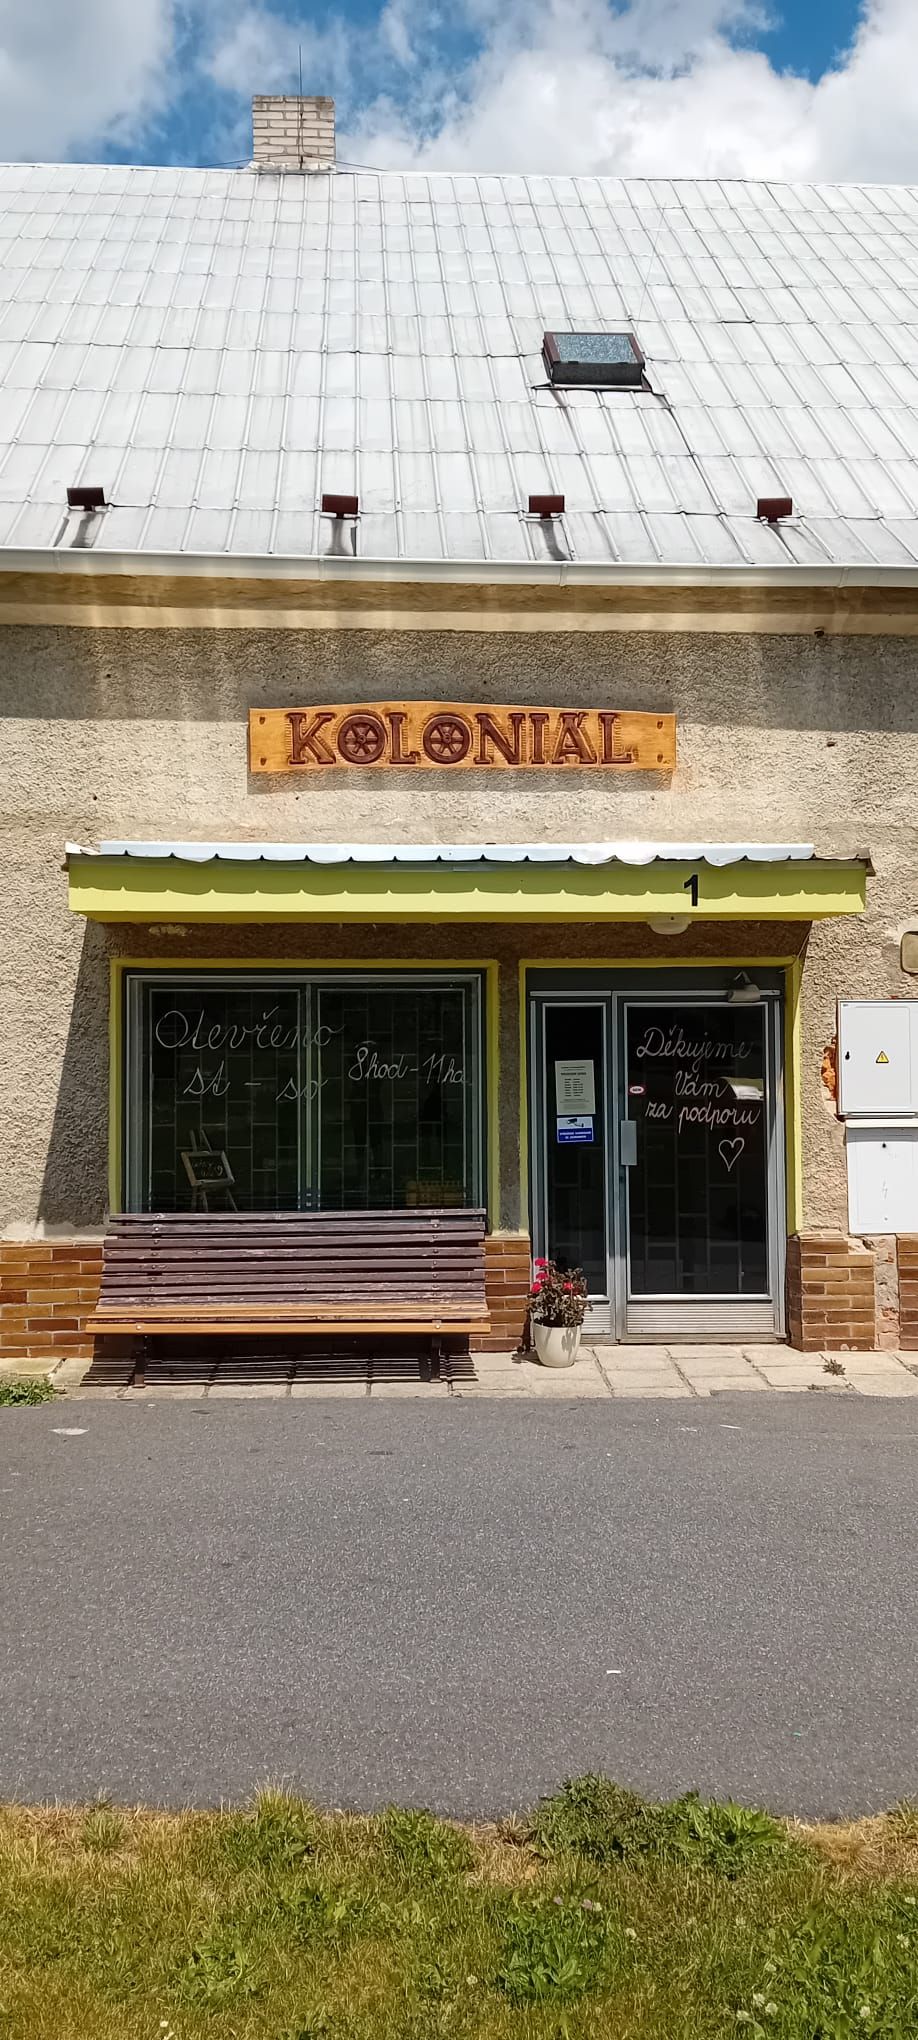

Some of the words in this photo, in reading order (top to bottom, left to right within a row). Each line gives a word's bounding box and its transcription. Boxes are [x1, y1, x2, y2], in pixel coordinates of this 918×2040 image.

[286, 711, 632, 766] KOLONIÁL
[683, 873, 699, 907] 1
[155, 1005, 346, 1050] Otevřeno
[636, 1023, 753, 1074] Děkujeme
[182, 1059, 232, 1097] st
[674, 1069, 730, 1099] Vám
[644, 1100, 674, 1120] za
[678, 1100, 761, 1135] podporu
